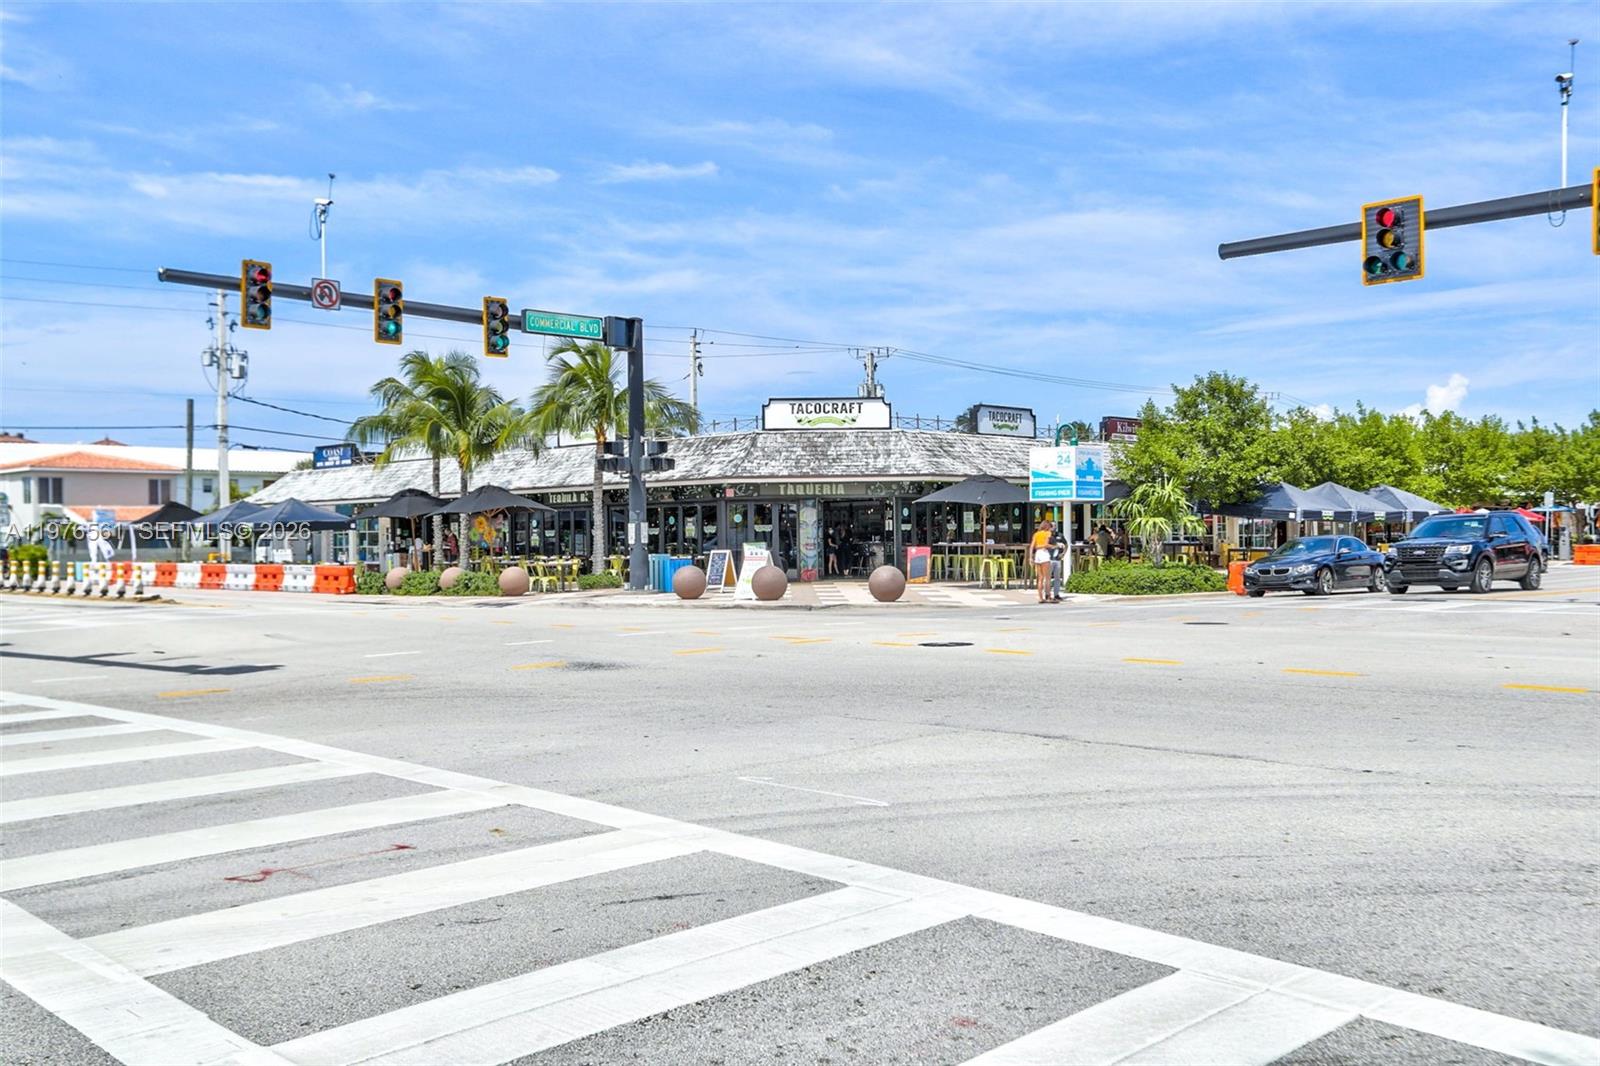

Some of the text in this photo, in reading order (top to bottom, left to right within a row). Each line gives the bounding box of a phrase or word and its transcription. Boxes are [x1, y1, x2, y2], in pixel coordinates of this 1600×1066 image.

[530, 316, 599, 334] COMMERCIAL BLVD
[789, 402, 863, 415] TACOCRAFT
[988, 410, 1022, 424] TACOCRAFT
[1117, 421, 1136, 434] Kilwi
[1056, 454, 1071, 465] 24
[779, 483, 846, 496] TAQUERIA
[549, 492, 578, 504] TEQUILA
